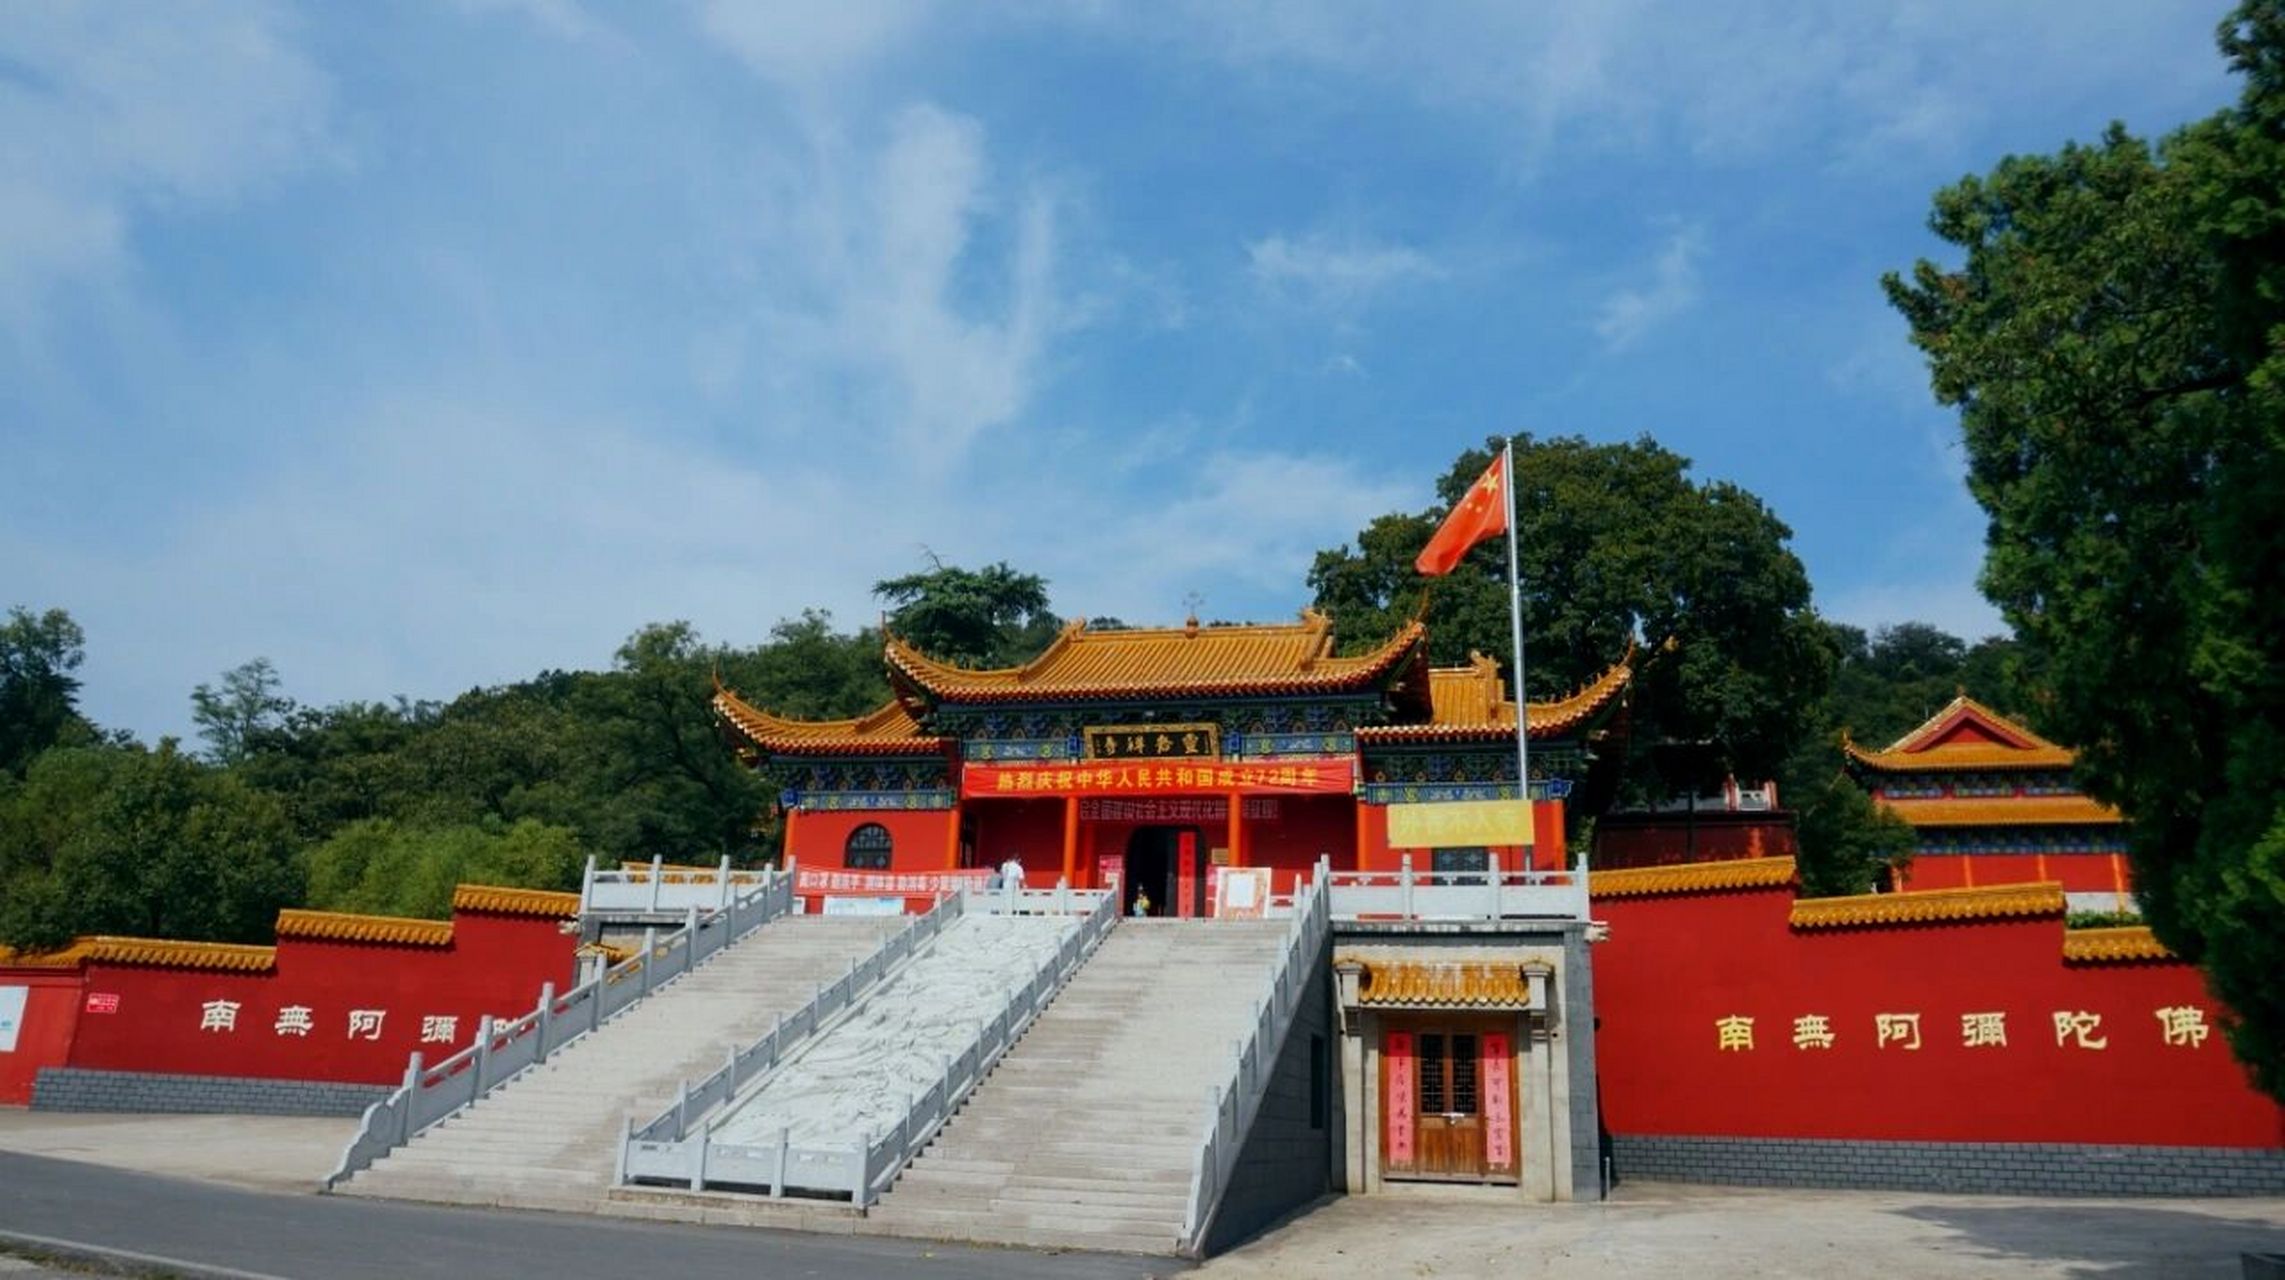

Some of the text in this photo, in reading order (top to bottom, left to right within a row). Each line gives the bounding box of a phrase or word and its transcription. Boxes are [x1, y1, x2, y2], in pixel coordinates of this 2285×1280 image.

[997, 767, 1319, 791] 热烈庆祝中华人民共和国成立72周年
[1715, 1006, 2211, 1053] 南無阿彌陀佛
